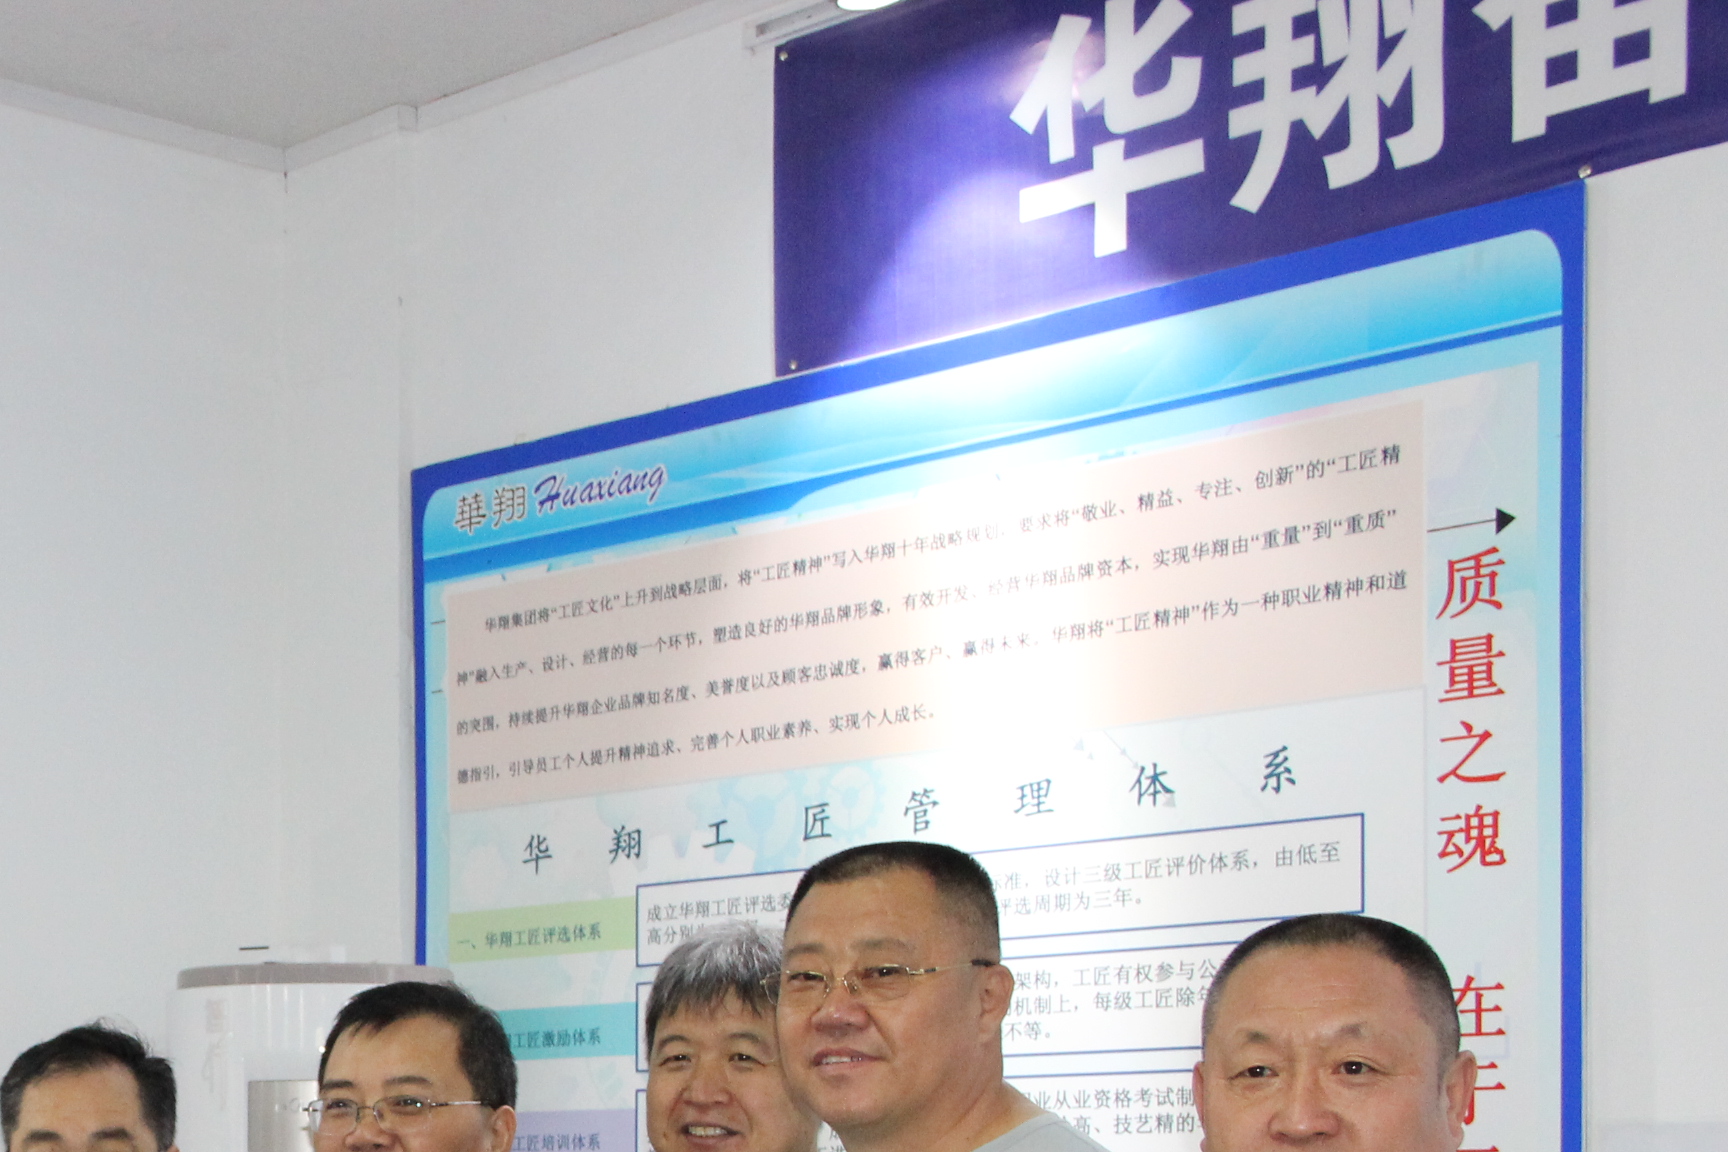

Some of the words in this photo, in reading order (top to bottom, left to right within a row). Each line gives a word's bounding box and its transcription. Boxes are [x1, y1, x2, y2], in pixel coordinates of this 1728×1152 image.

[532, 465, 667, 515] Huaxiang
[1435, 546, 1507, 874] 质量之魂
